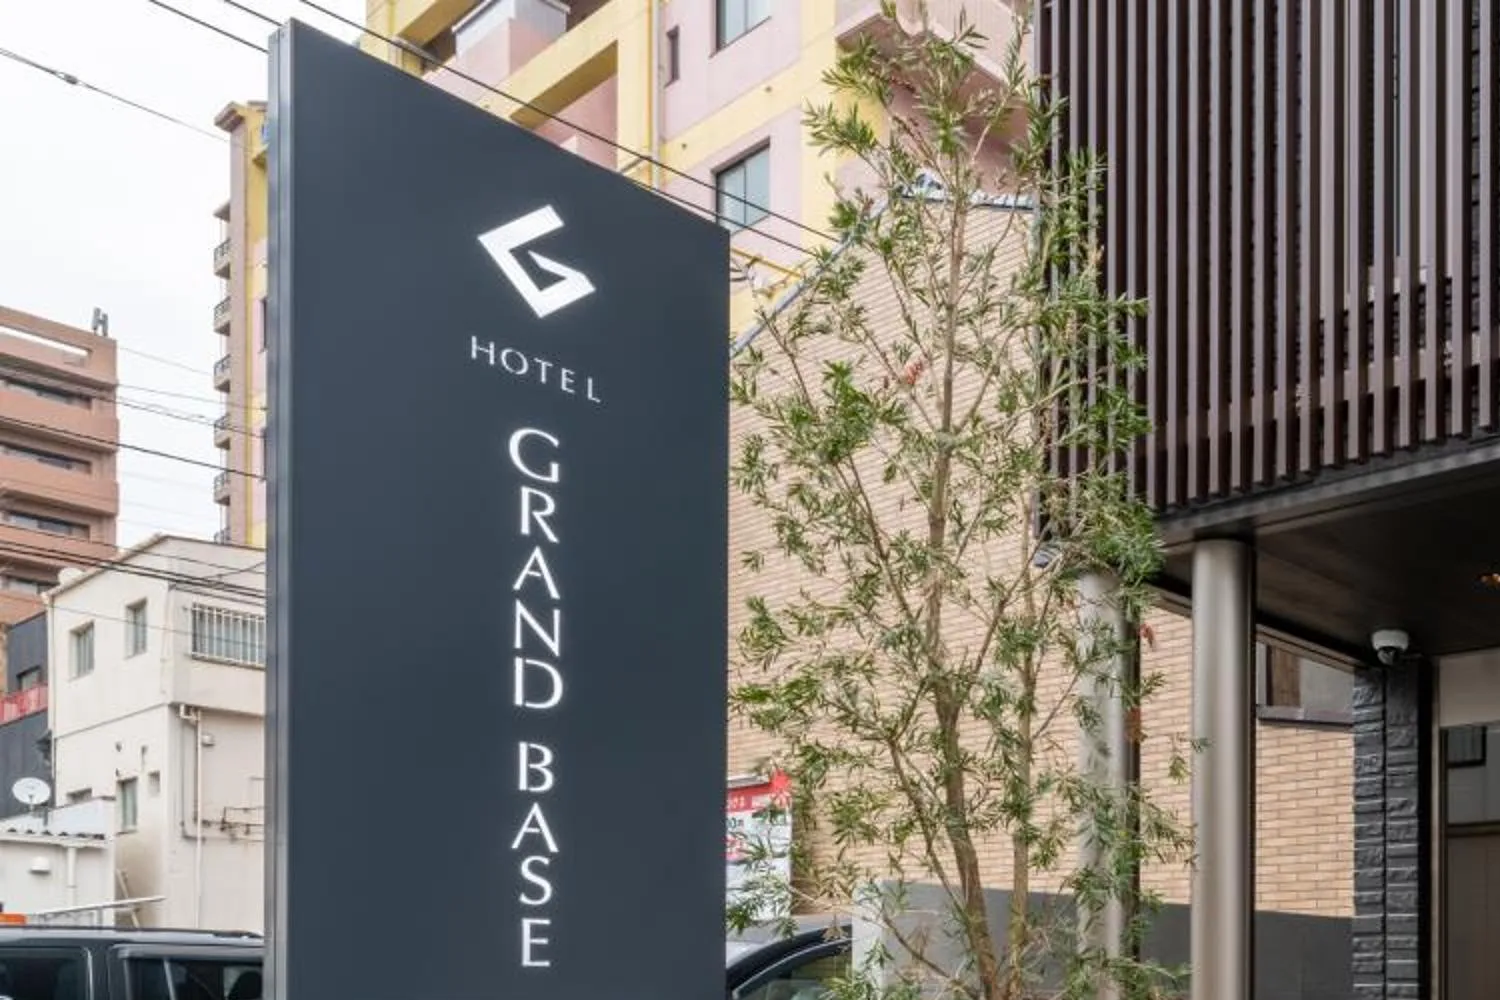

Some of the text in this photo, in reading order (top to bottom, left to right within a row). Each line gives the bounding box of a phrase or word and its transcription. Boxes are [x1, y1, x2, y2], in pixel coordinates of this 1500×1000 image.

[469, 334, 602, 404] HOTEL
[507, 426, 565, 967] GRAND BASE
